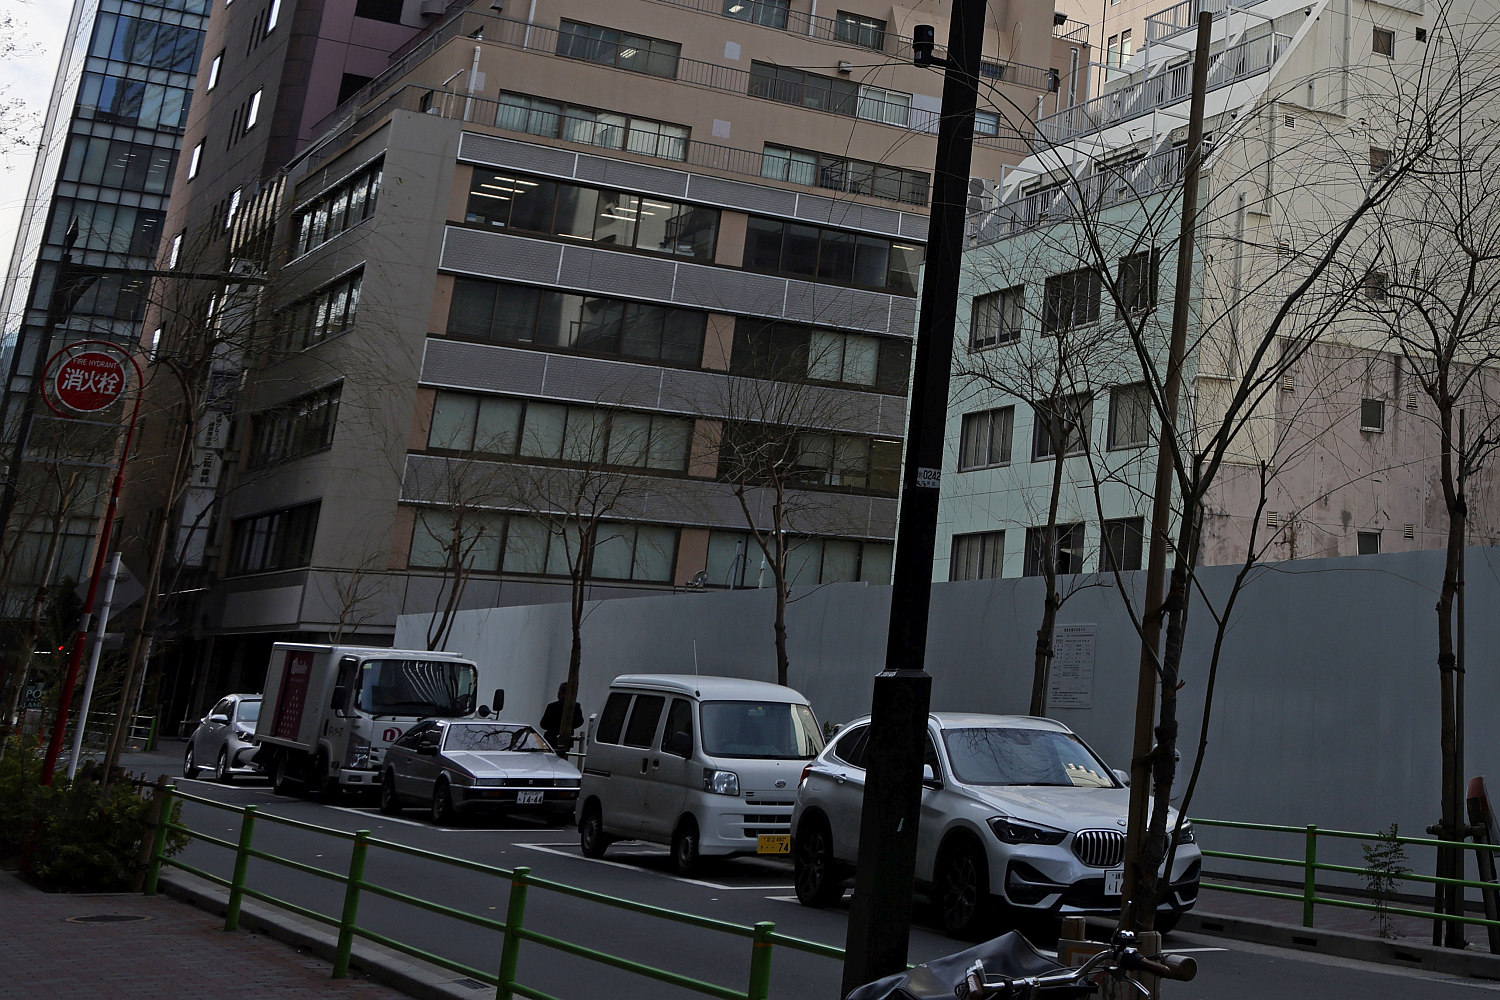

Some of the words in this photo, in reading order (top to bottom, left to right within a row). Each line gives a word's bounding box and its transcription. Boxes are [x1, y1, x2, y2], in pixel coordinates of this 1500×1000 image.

[73, 358, 87, 366] FIRE
[88, 359, 118, 369] HYDRANT
[61, 367, 120, 396] 消火栓
